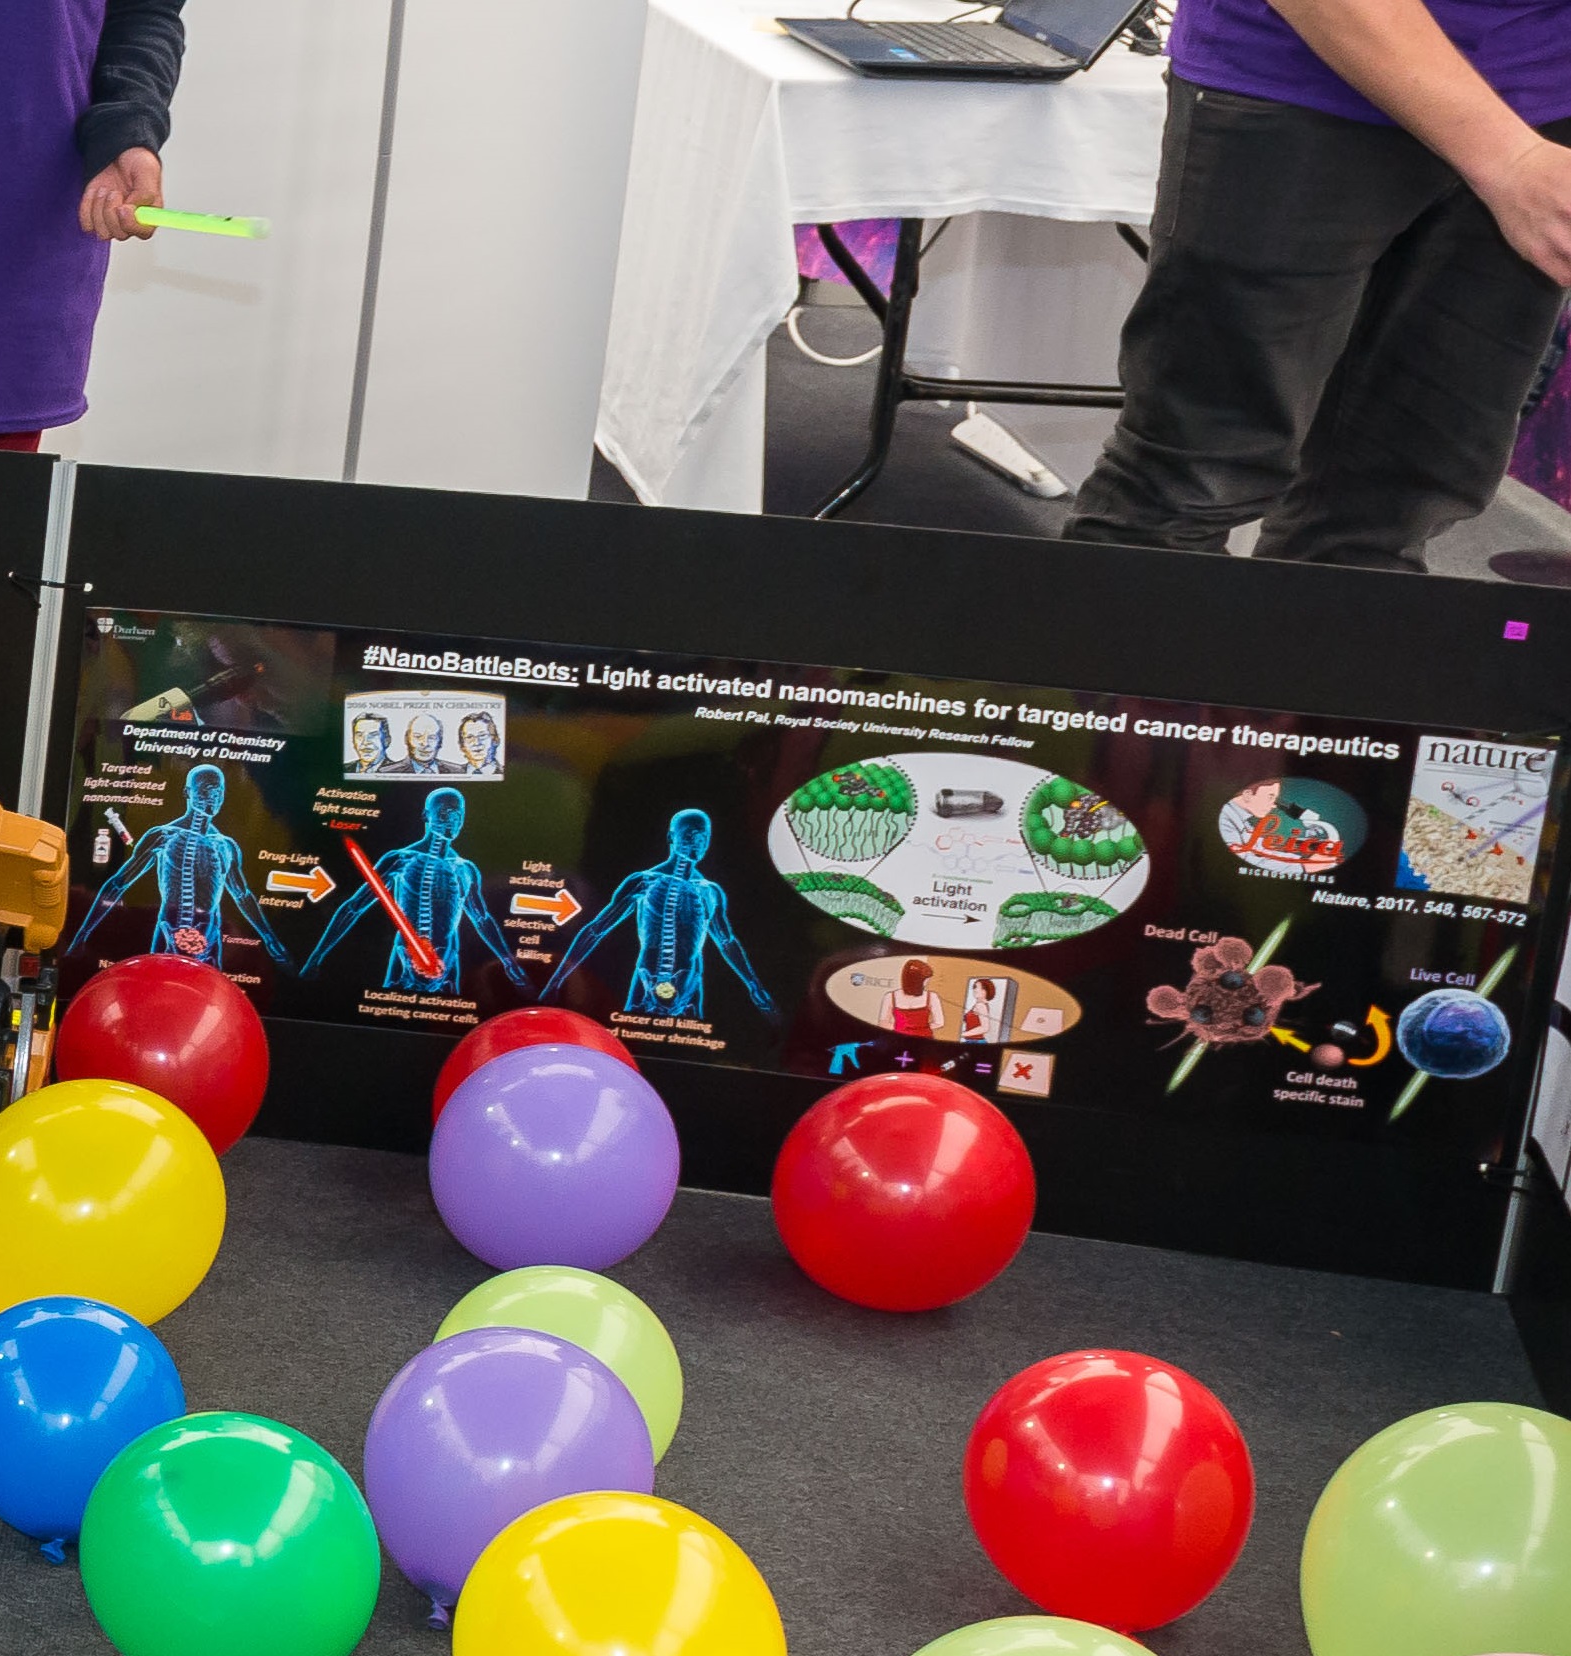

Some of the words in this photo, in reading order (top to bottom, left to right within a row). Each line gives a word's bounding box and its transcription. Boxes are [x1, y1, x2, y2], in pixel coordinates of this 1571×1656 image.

[114, 624, 155, 635] Durham
[362, 645, 580, 684] #NanoBattleBots:
[587, 663, 652, 691] Light
[657, 673, 772, 699] activated
[779, 684, 966, 717] nanomachines
[973, 698, 1012, 720] for
[1018, 703, 1128, 732] targeted
[1133, 718, 1226, 742] cancer
[1231, 725, 1400, 760] therapeutics
[171, 708, 193, 721] Lab
[694, 706, 743, 722] Robert
[745, 710, 771, 725] Pal,
[774, 714, 811, 728] Royal
[813, 717, 860, 733] Society
[862, 722, 927, 739] University
[928, 729, 988, 745] Research
[991, 734, 1035, 749] Fellow
[123, 724, 199, 741] Department
[201, 730, 216, 742] of
[218, 732, 286, 751] Chemistry
[134, 741, 200, 758] University
[202, 747, 217, 758] of
[219, 748, 271, 763] Durham
[1427, 741, 1546, 773] nature
[102, 762, 152, 776] Targeted
[83, 777, 167, 791] light-activated
[82, 794, 164, 806] nanomachines
[316, 787, 377, 801] Activation
[313, 802, 340, 814] light
[341, 807, 381, 817] source
[1228, 814, 1345, 864] Leica
[258, 850, 320, 866] Drug-Light
[522, 860, 552, 874] Light
[509, 876, 565, 889] activated
[932, 881, 973, 896] Light
[258, 895, 304, 909] interval
[913, 895, 987, 912] activation
[1312, 889, 1371, 910] Nature,
[1374, 896, 1418, 914] 2017,
[1423, 901, 1456, 918] 548,
[1461, 905, 1527, 927] 567-572
[504, 918, 557, 932] selective
[222, 934, 262, 946] Tumour
[519, 934, 540, 945] cell
[1144, 924, 1186, 940] Dead
[1189, 929, 1218, 943] Cell
[516, 949, 553, 964] killing
[1410, 967, 1442, 982] Live
[1446, 972, 1476, 987] Cell
[364, 990, 417, 1004] Localized
[419, 995, 477, 1010] activation
[358, 1004, 411, 1019] targeting
[412, 1010, 450, 1022] cancer
[452, 1012, 479, 1024] cells
[610, 1011, 651, 1025] Cancer
[652, 1017, 674, 1027] cell
[676, 1018, 713, 1034] killing
[621, 1029, 666, 1042] tumour
[668, 1033, 726, 1050] shrinkage
[1286, 1071, 1313, 1084] Cell
[1315, 1074, 1357, 1089] death
[1273, 1089, 1327, 1103] specific
[1328, 1095, 1364, 1108] stain
